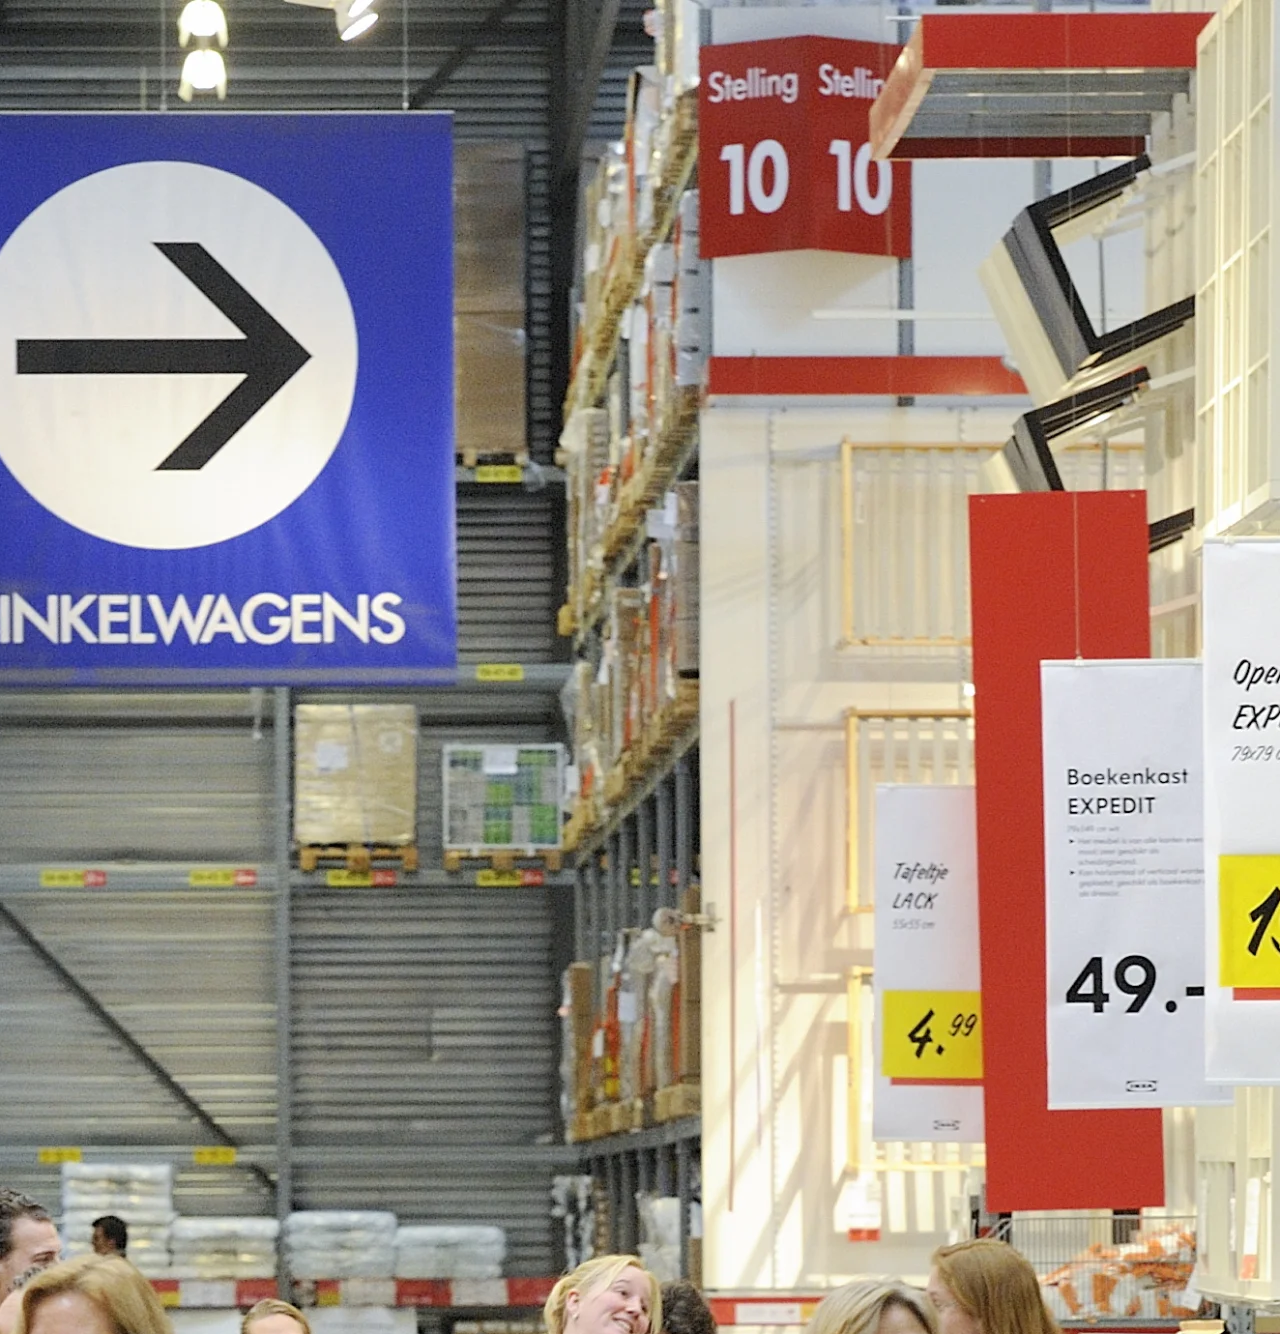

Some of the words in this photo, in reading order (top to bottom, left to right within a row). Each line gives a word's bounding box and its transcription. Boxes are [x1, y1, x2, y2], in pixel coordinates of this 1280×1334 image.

[708, 70, 799, 103] Stelling
[818, 63, 886, 99] Stellin
[720, 139, 790, 215] 10
[829, 139, 893, 216] 10
[1231, 744, 1274, 764] 79x79
[1068, 767, 1189, 785] Boekenkast
[1068, 797, 1155, 814] EXPEDIT
[893, 862, 950, 885] Tafeltje
[892, 892, 939, 910] LACK
[907, 1008, 978, 1059] 4.99
